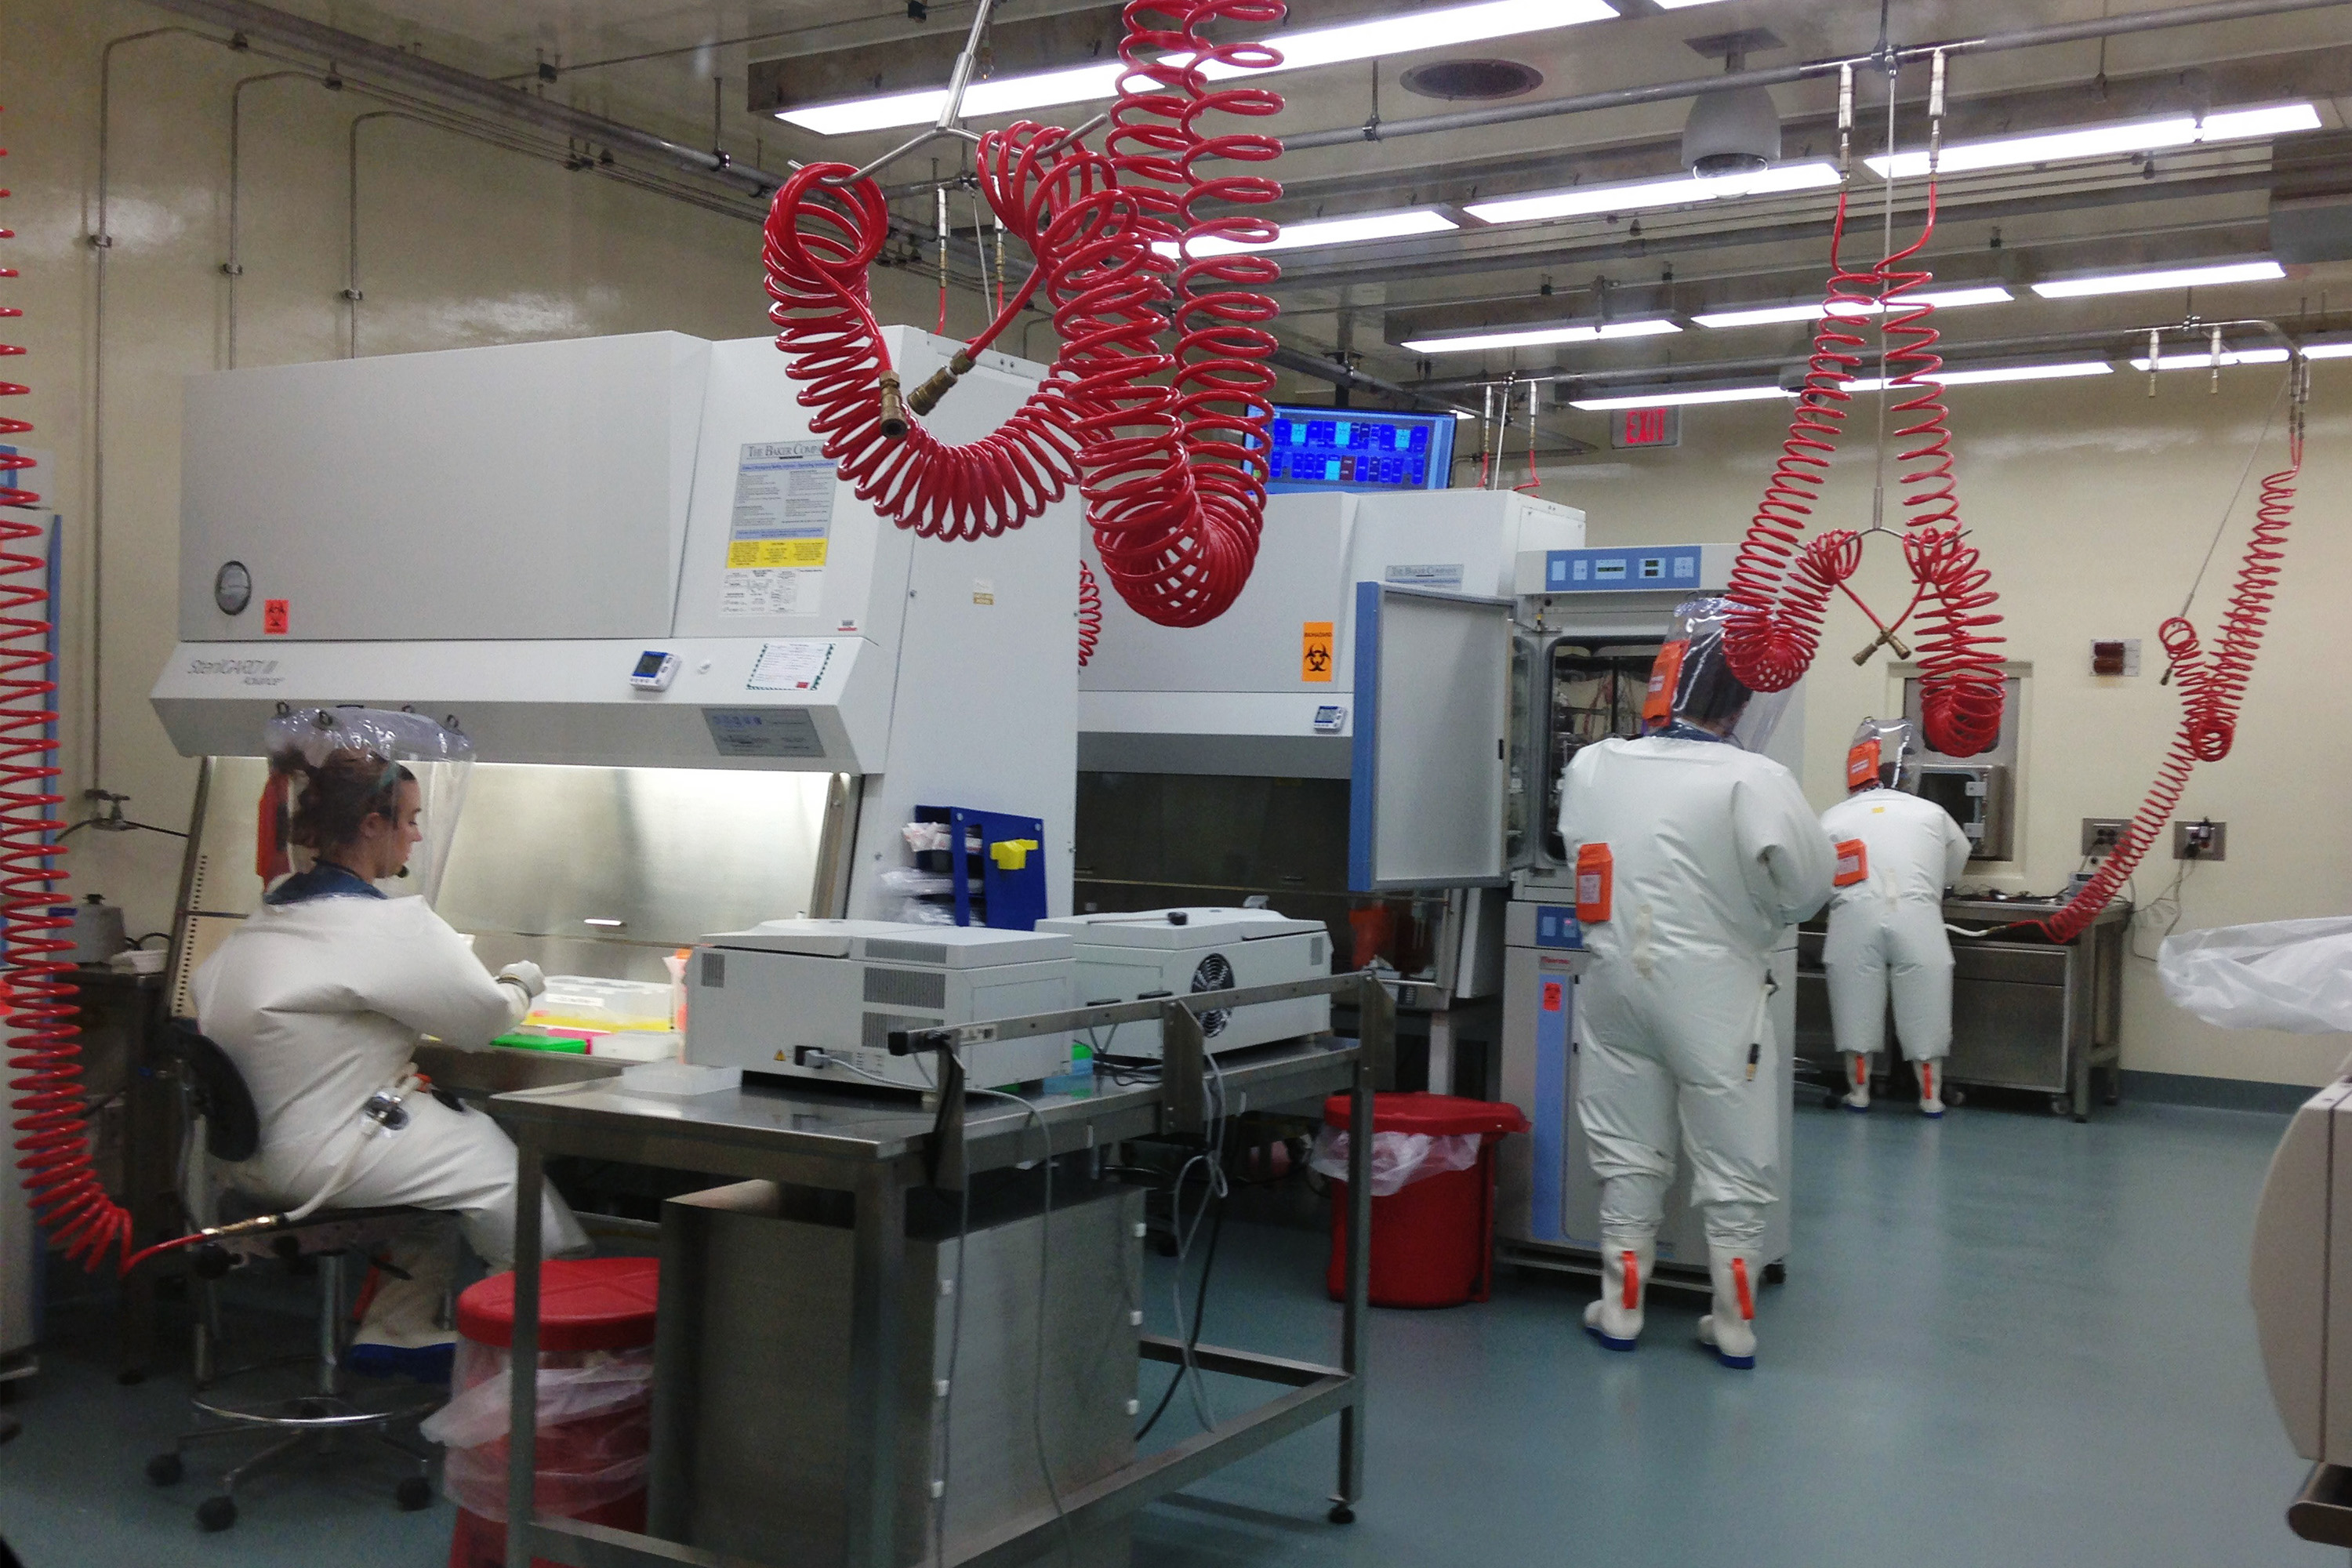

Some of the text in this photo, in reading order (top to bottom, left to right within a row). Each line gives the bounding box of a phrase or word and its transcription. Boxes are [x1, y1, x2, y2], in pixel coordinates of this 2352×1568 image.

[1626, 408, 1668, 444] EXIT
[748, 446, 763, 457] THE
[765, 445, 792, 456] BAKER
